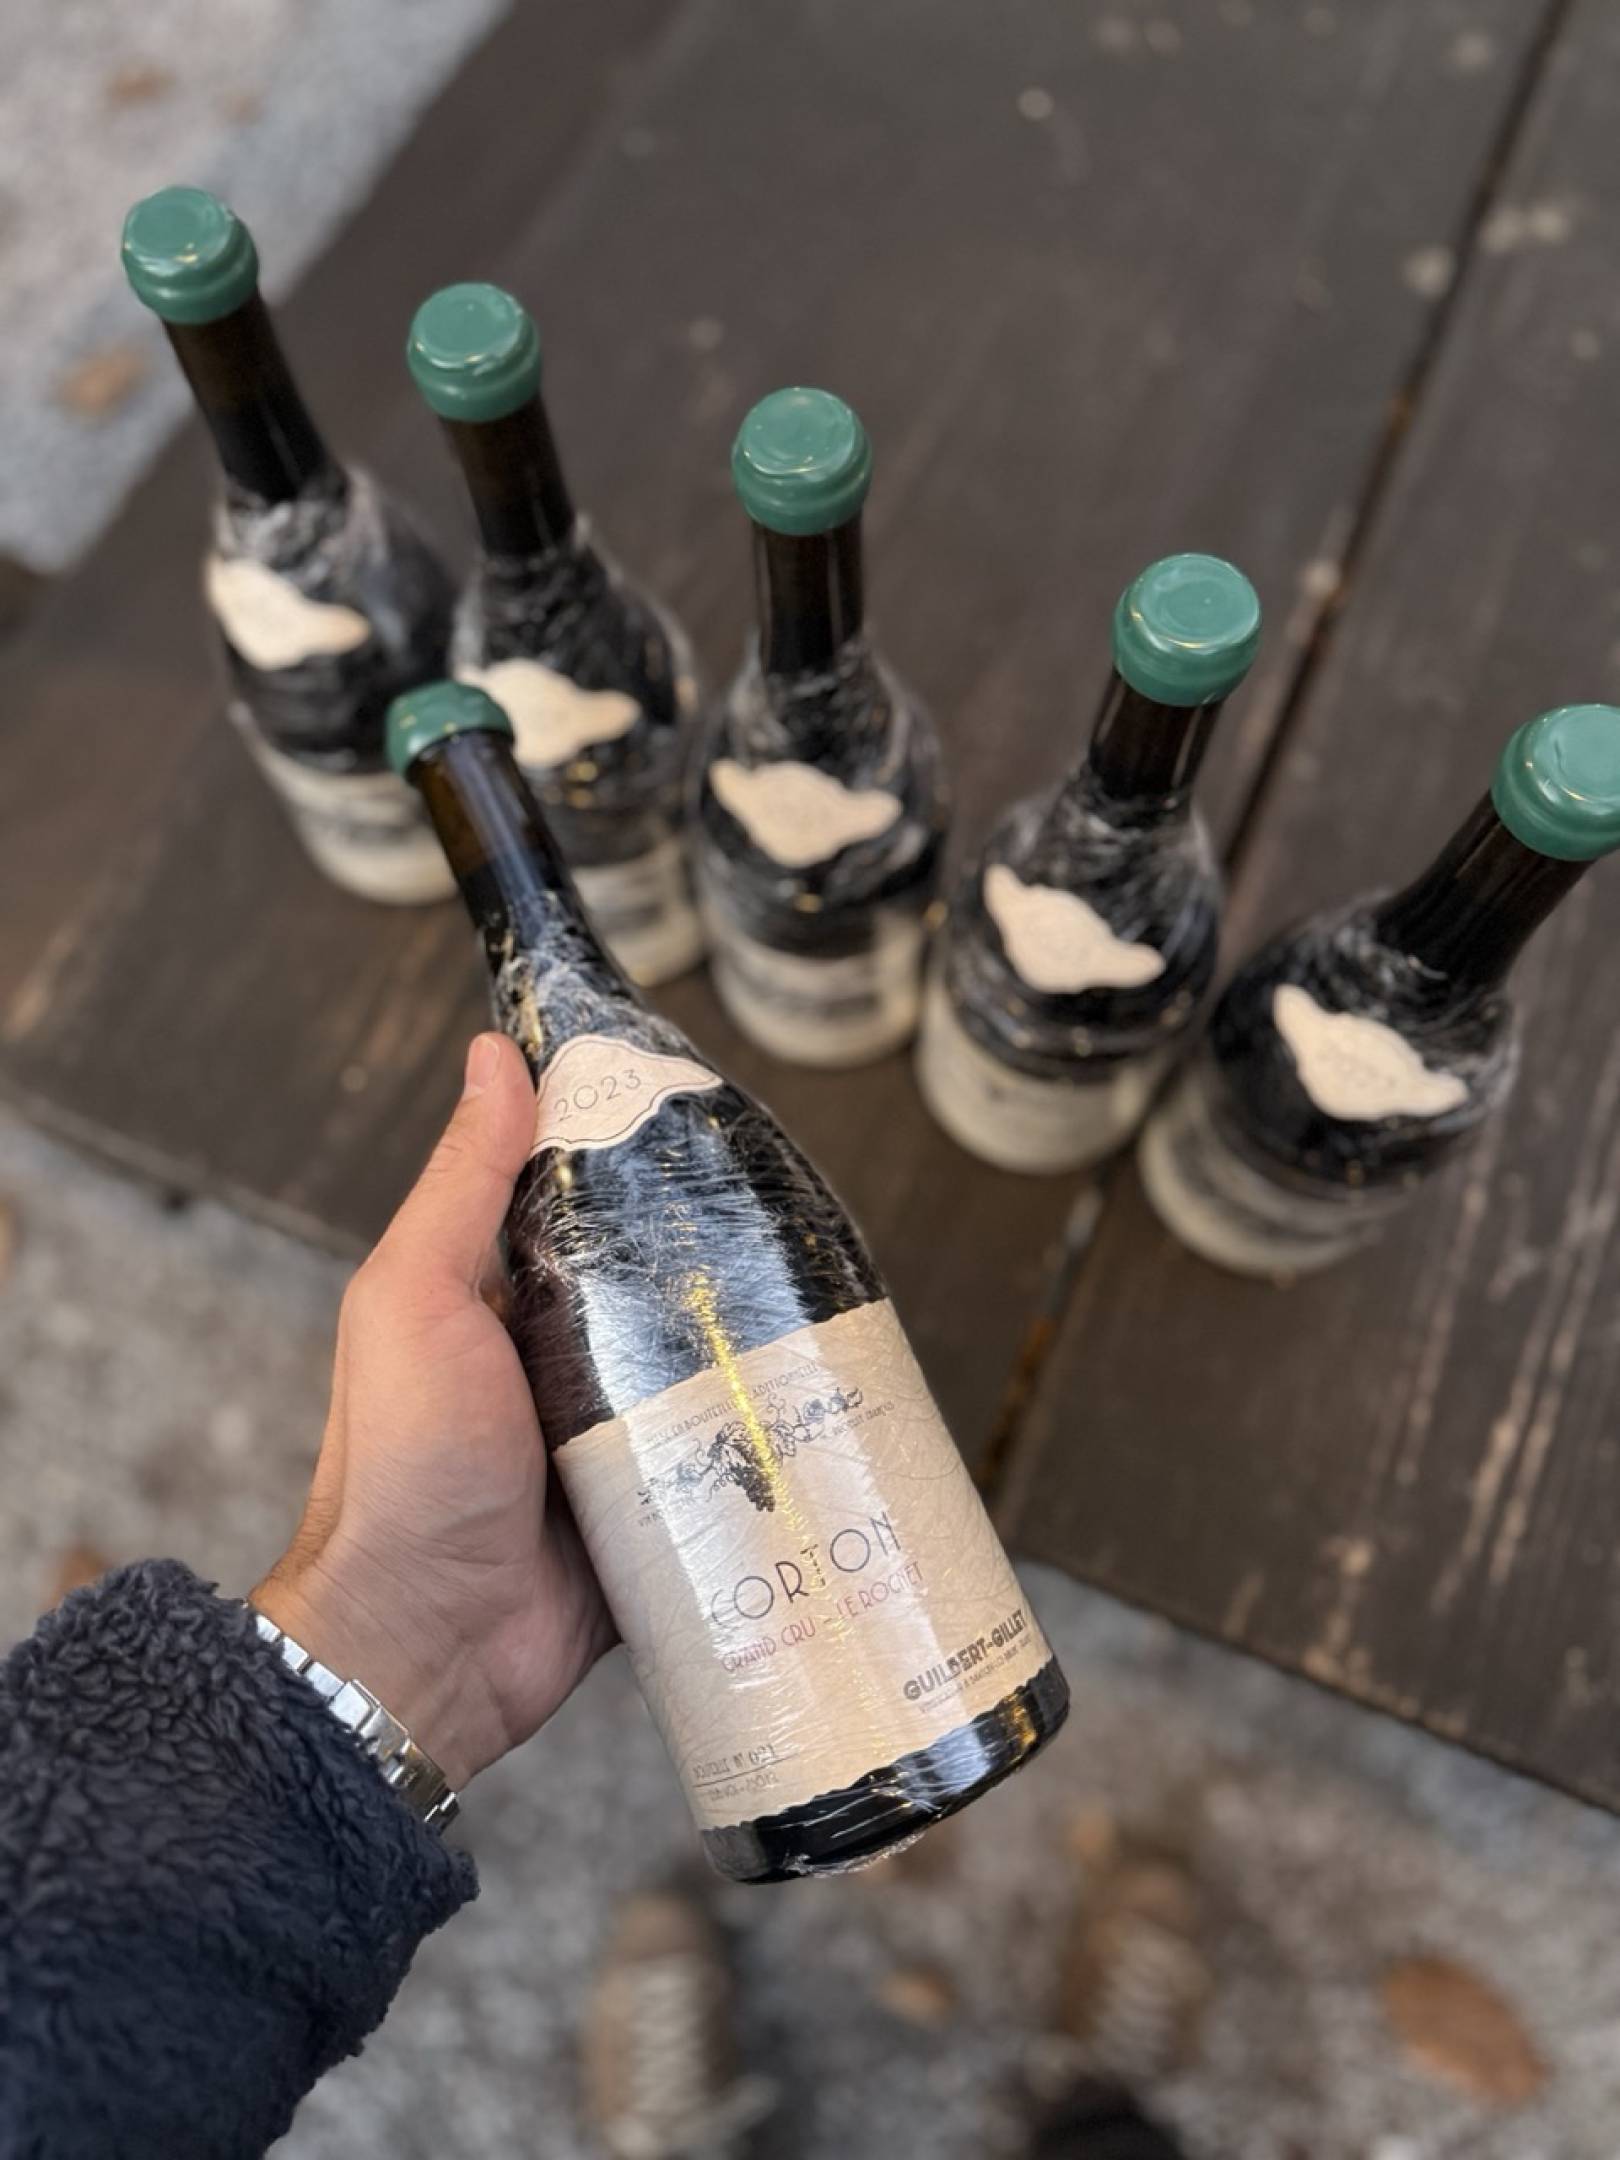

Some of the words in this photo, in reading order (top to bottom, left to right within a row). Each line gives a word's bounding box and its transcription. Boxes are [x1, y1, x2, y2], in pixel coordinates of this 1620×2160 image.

[553, 1068, 642, 1122] 2023
[711, 1511, 901, 1628] CORTON
[721, 1636, 777, 1673] GRAND
[780, 1616, 817, 1647] CRU
[903, 1608, 1028, 1701] GUILBERT-GILLET
